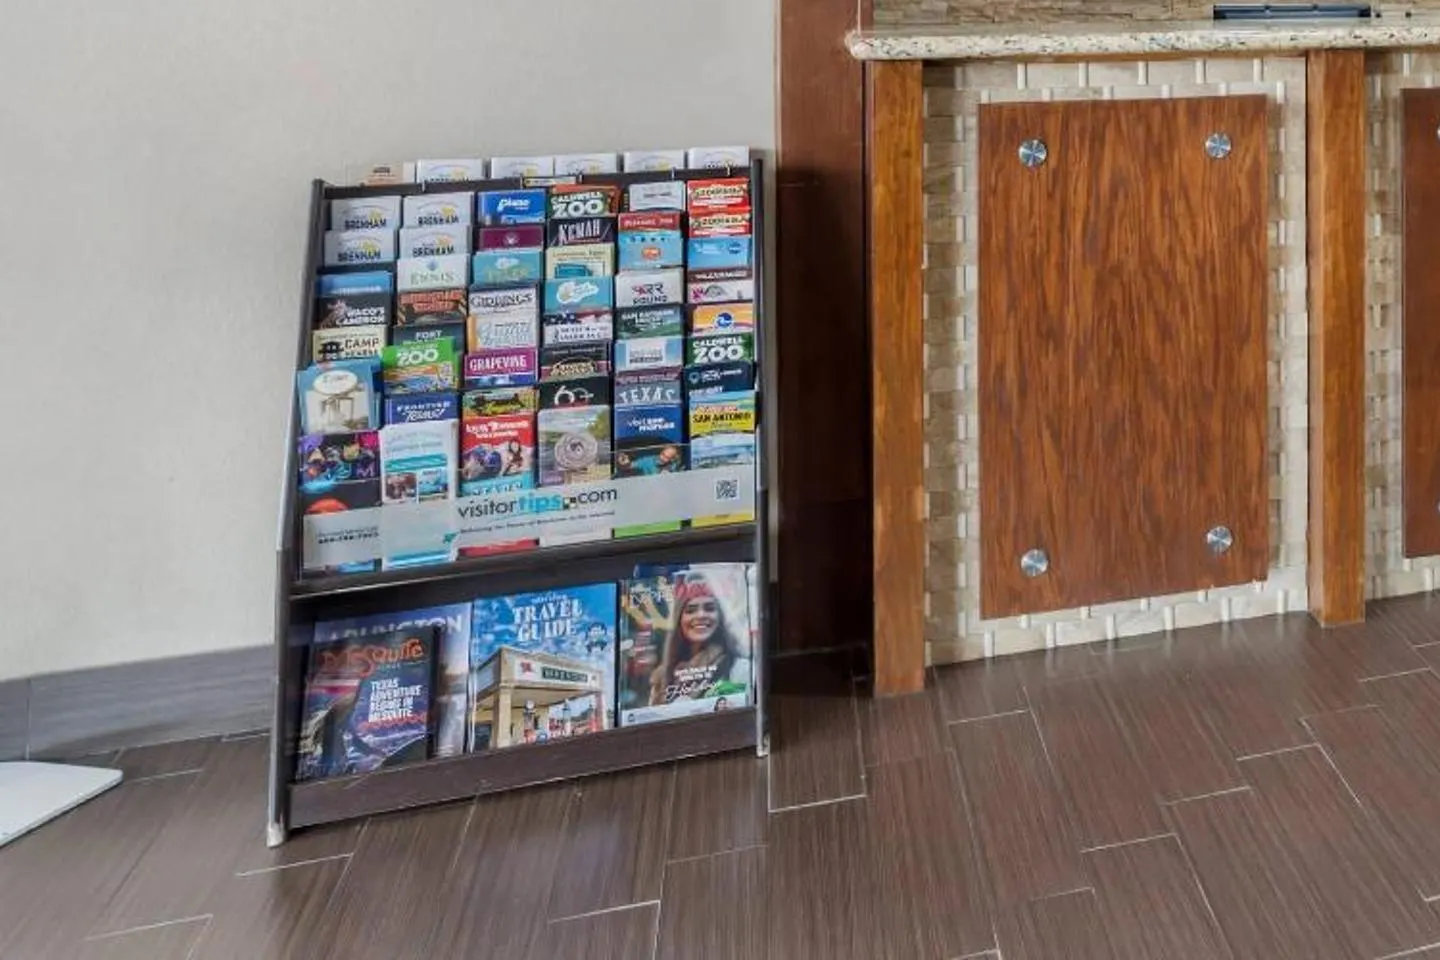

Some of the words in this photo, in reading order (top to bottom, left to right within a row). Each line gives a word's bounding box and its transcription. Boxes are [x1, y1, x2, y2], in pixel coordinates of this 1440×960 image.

[552, 200, 604, 219] ZOO
[344, 218, 388, 231] BRENHAM
[558, 219, 601, 246] KEMAH
[337, 249, 382, 262] BRENHAM
[411, 246, 455, 258] BRENHAM
[344, 337, 380, 349] CAMP
[397, 348, 439, 366] ZOO
[469, 355, 528, 371] GRAPEVINE
[694, 344, 745, 364] ZOO
[619, 386, 676, 405] TEXAS
[512, 599, 583, 625] TRAVEL
[517, 619, 578, 641] GUIDE
